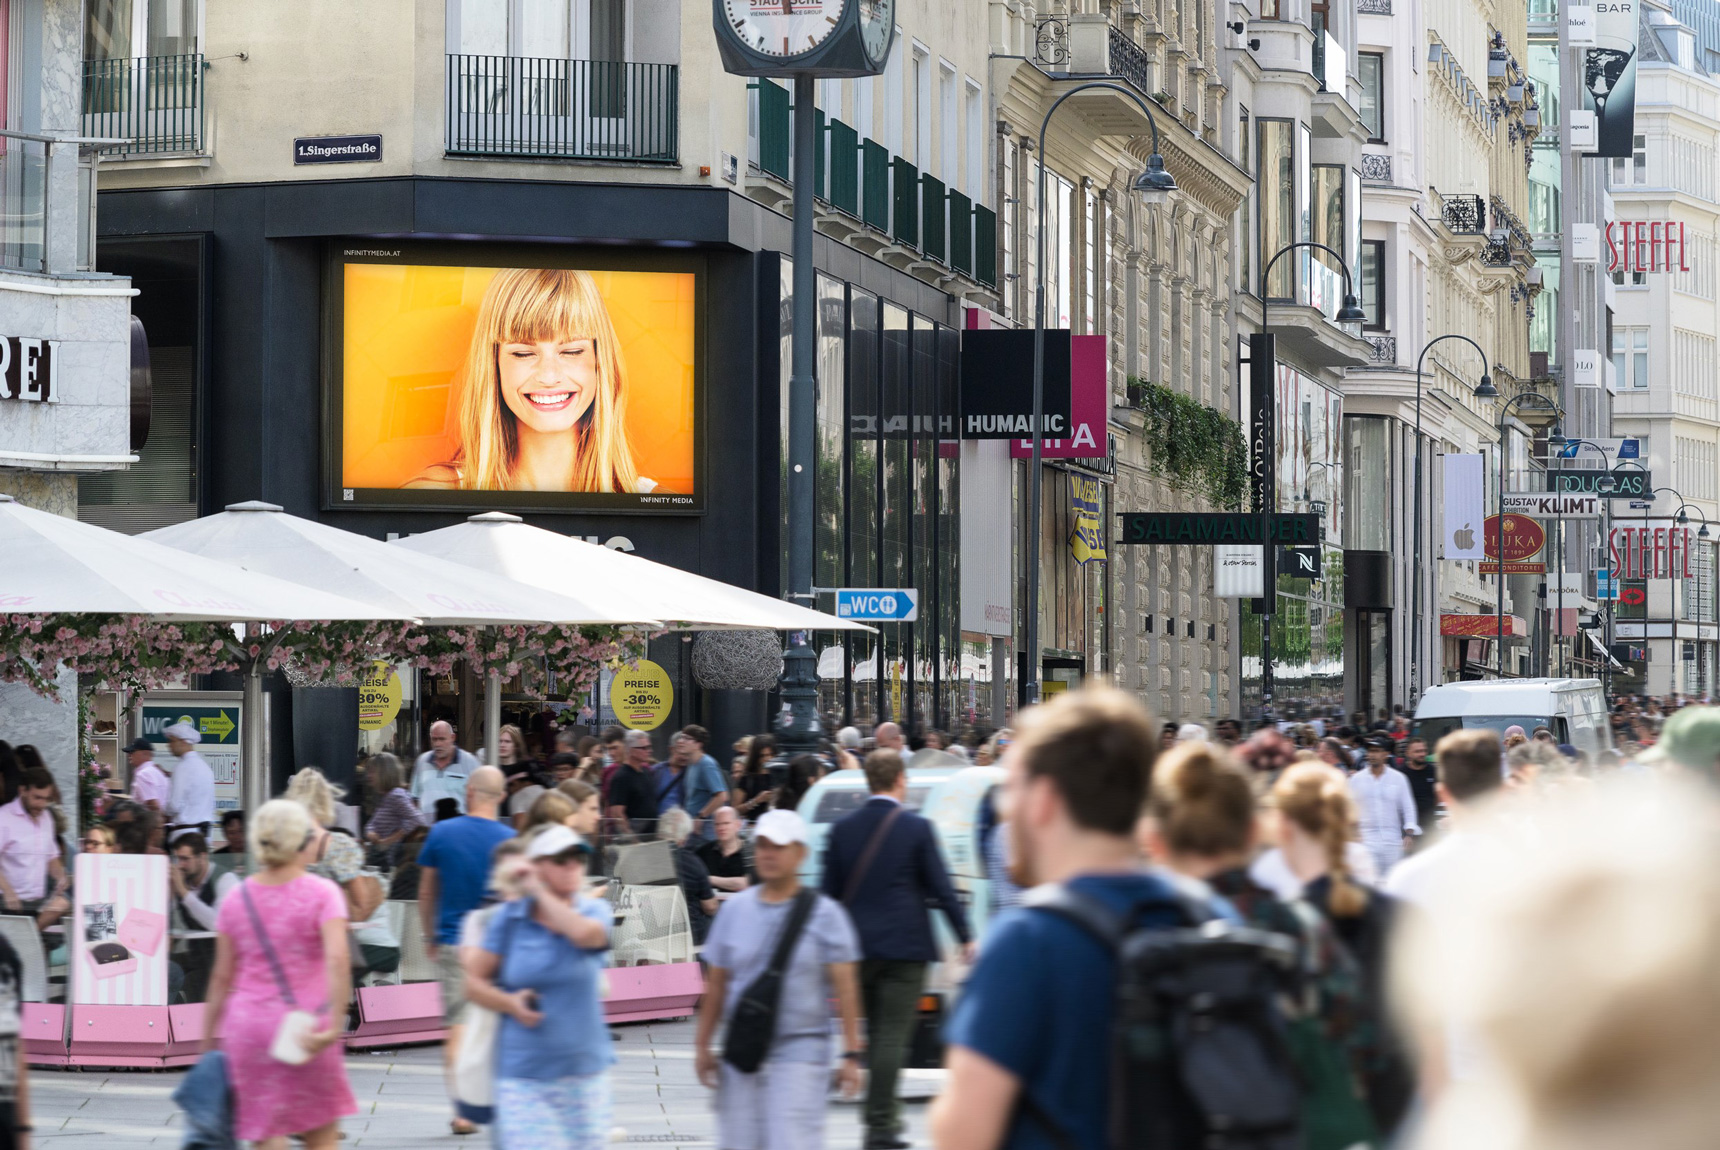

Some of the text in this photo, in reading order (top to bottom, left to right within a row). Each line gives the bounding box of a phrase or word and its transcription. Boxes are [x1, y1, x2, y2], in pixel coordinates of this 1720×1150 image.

[1597, 3, 1631, 13] BAR
[1569, 18, 1586, 27] hloé
[1605, 221, 1690, 272] STEFFL
[343, 249, 401, 257] INFINITYMEDIA.AT
[640, 496, 670, 504] INFINITY
[1503, 497, 1597, 514] GUSTAV KLIMT
[1610, 527, 1693, 579] STEFFL
[851, 596, 879, 613] WC
[624, 680, 660, 688] PREISE
[623, 694, 661, 705] -30%
